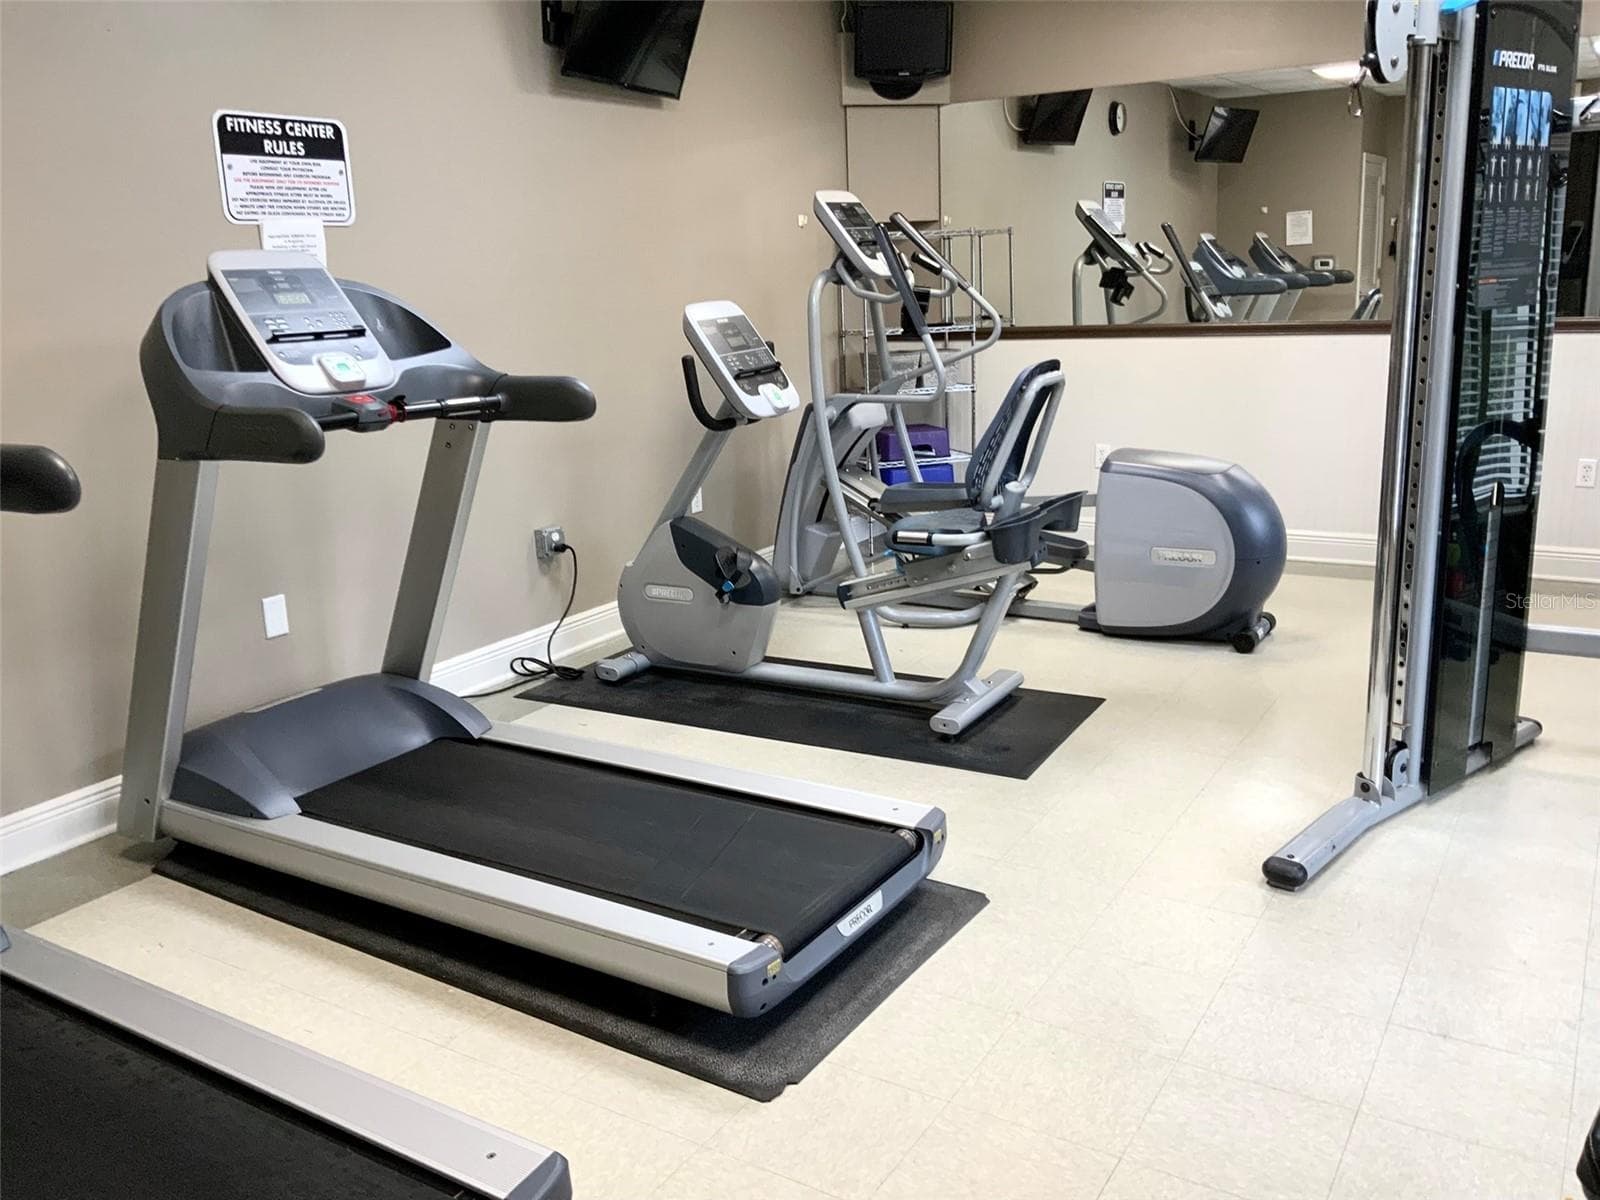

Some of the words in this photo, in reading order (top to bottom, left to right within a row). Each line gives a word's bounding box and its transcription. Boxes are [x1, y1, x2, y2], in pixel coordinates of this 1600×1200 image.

[1498, 50, 1535, 70] PRECOR
[225, 116, 282, 135] FITNESS
[285, 121, 336, 139] CENTER
[263, 139, 306, 156] RULES
